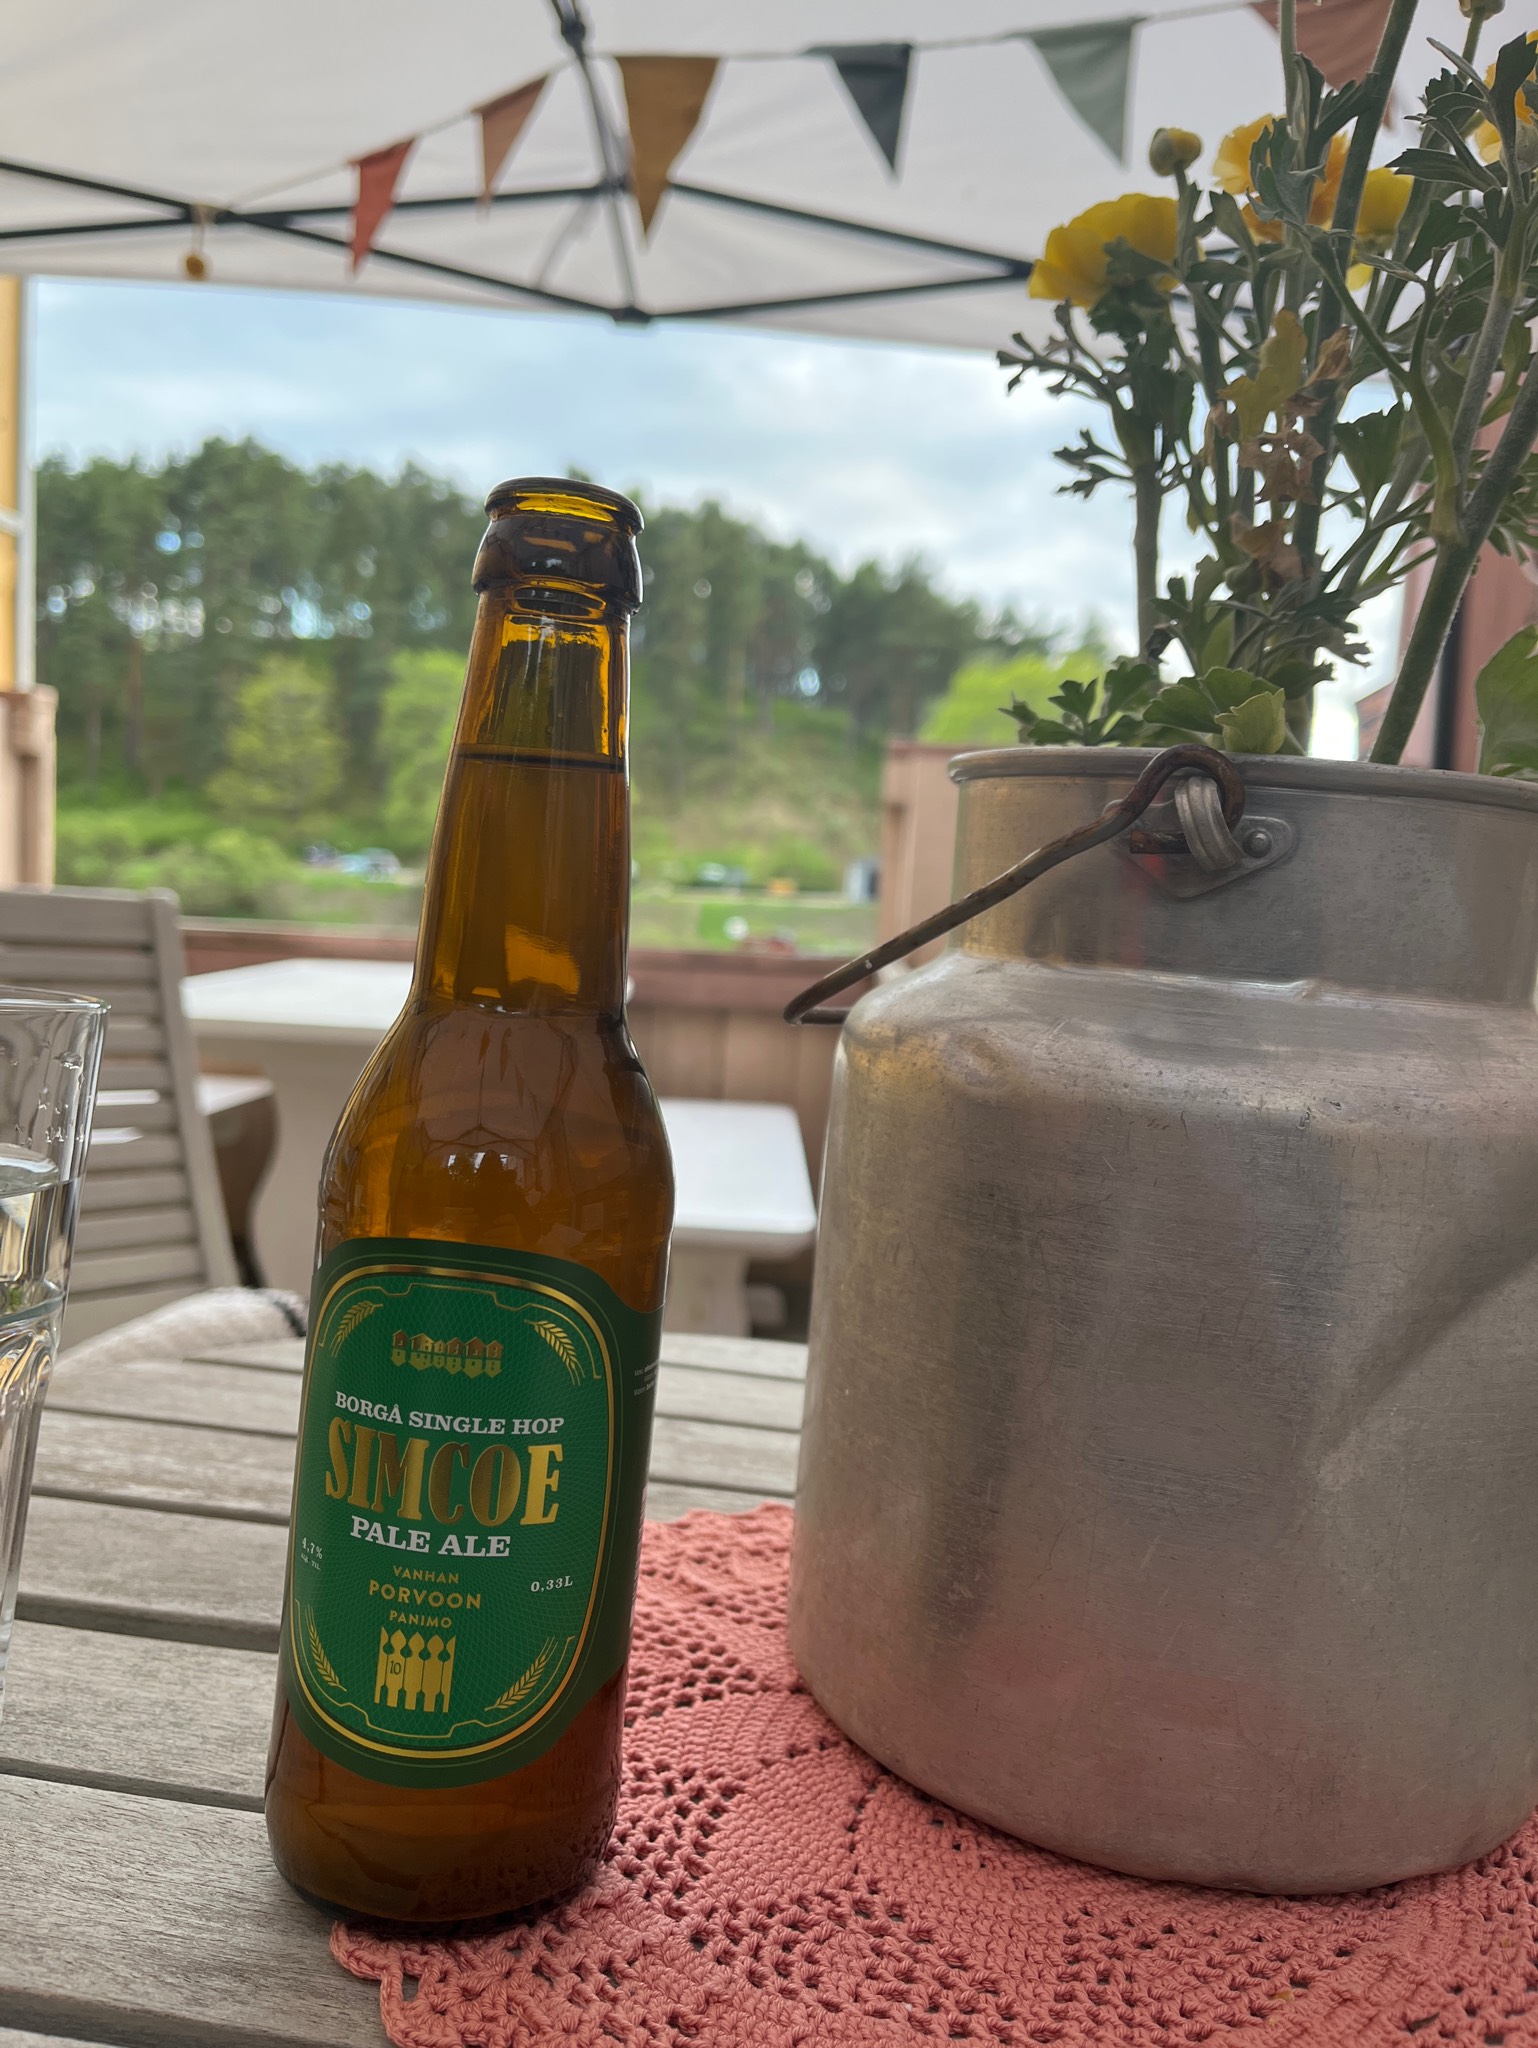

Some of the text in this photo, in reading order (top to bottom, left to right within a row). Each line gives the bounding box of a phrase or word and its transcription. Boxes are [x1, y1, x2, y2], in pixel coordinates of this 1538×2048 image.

[335, 1391, 565, 1435] BORGÅ SINGLE HOP
[325, 1416, 564, 1527] SIMCOE
[350, 1515, 511, 1557] PALE ALE
[393, 1565, 460, 1584] VANHAN
[368, 1579, 482, 1610] PORVOON
[389, 1609, 453, 1629] PANIMO
